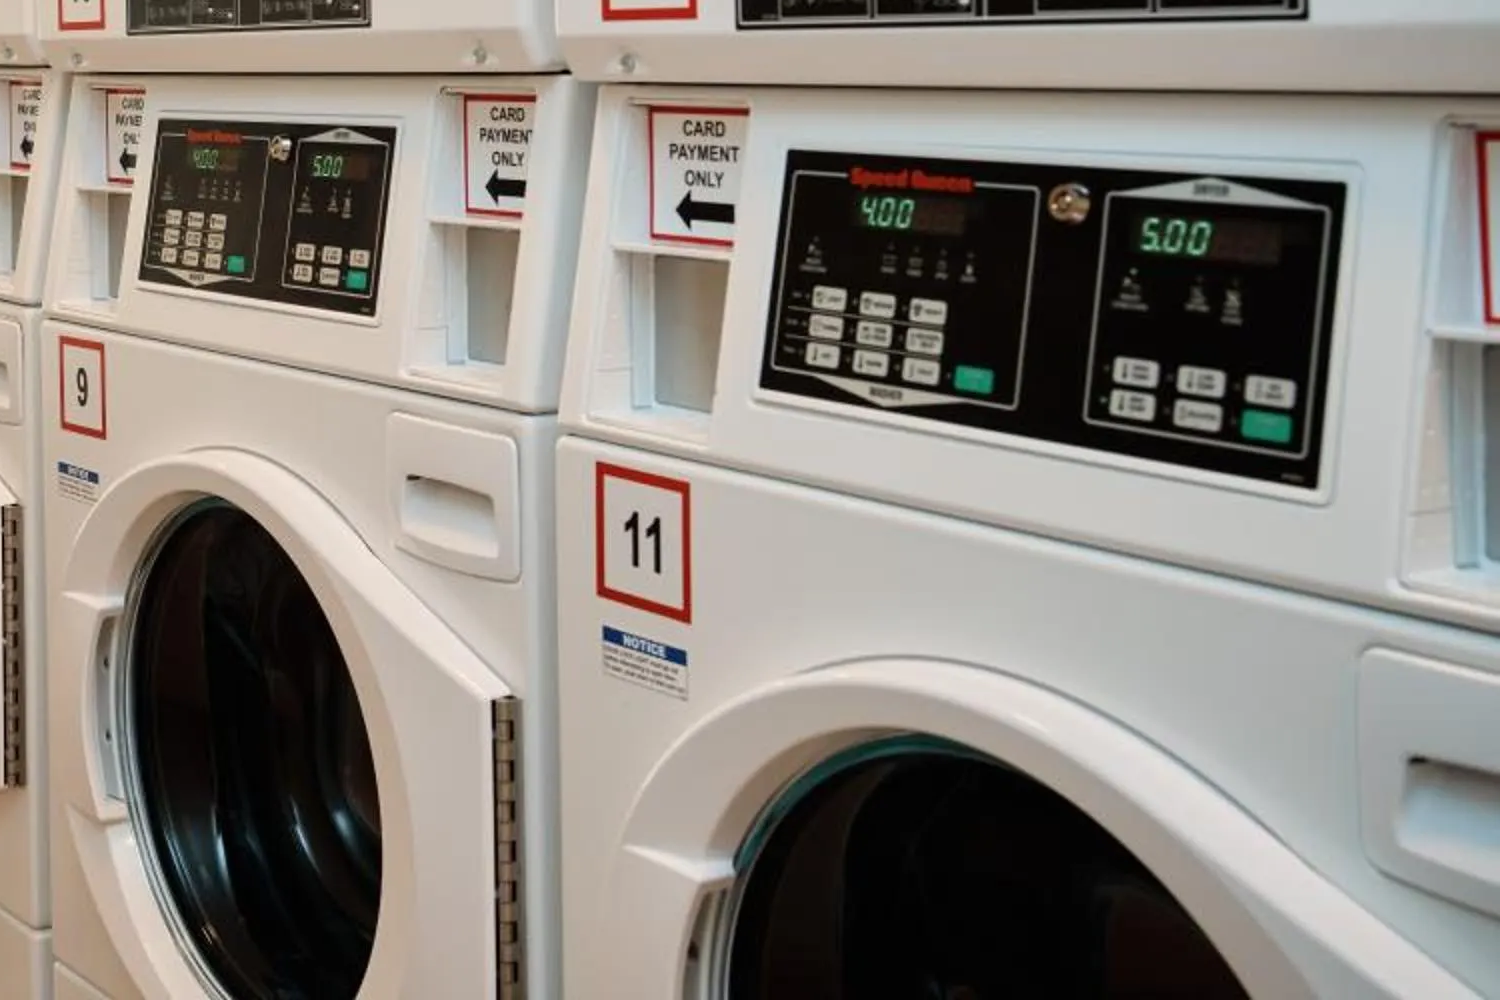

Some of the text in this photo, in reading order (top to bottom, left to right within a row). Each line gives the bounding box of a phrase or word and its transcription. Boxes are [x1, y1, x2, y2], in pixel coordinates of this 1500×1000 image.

[489, 106, 525, 122] CARD
[683, 119, 726, 138] CARD
[491, 151, 525, 167] ONLY
[669, 143, 740, 162] PAYMENT
[684, 169, 724, 188] ONLY
[76, 367, 89, 407] 9
[624, 511, 662, 575] 11
[622, 633, 668, 659] NOTICE
